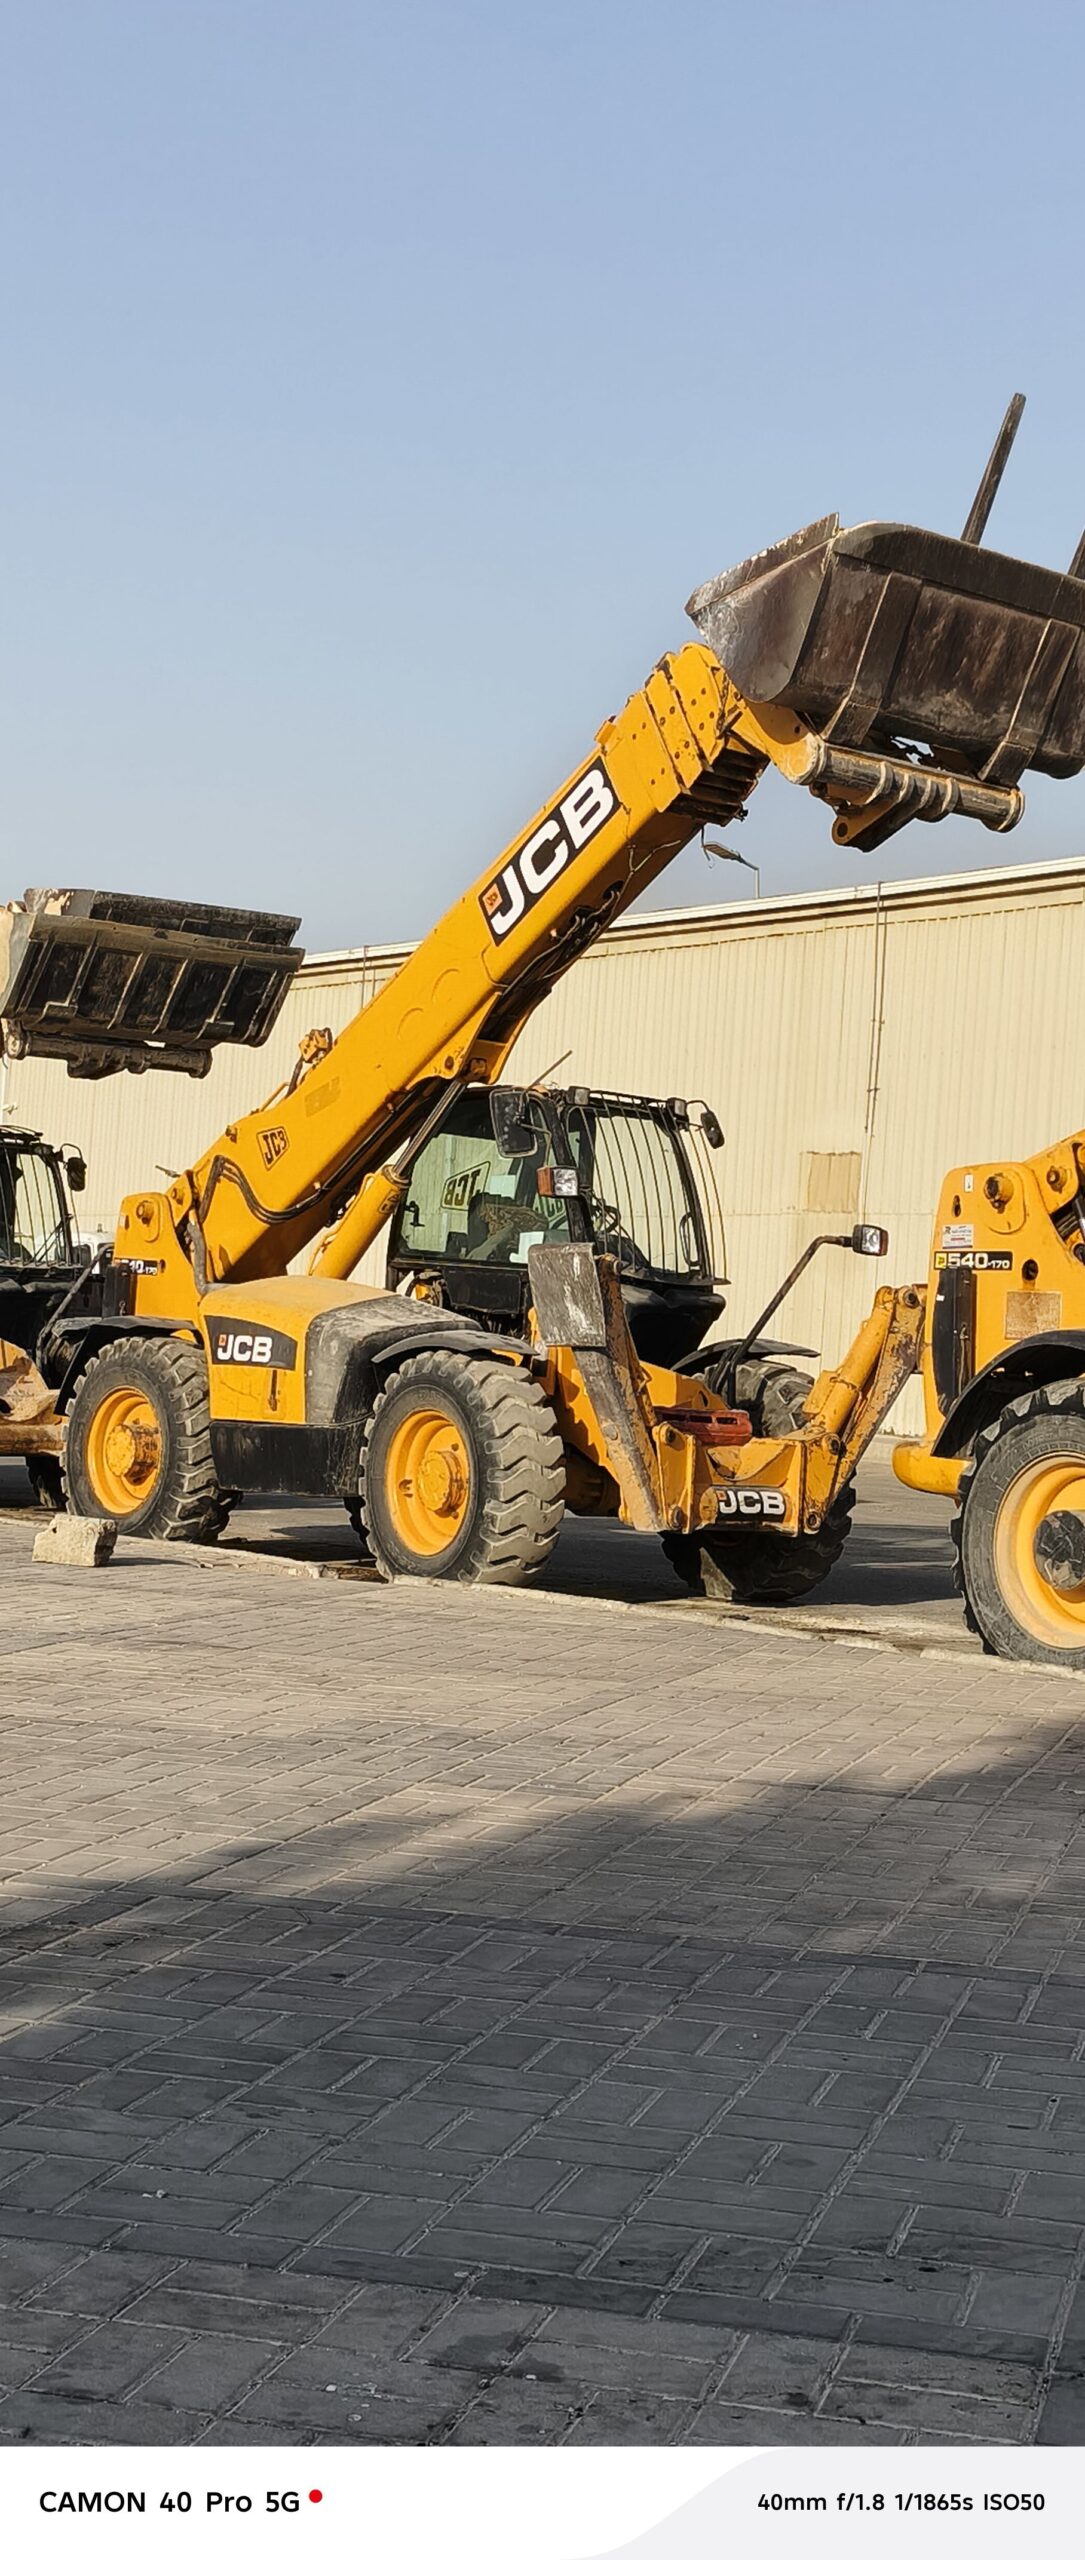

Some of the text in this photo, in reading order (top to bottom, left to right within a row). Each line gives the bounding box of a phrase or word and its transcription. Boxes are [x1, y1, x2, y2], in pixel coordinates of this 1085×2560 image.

[490, 769, 614, 935] JCB
[262, 1130, 287, 1165] JCB
[217, 1334, 272, 1363] JCB
[719, 1490, 785, 1515] JCB
